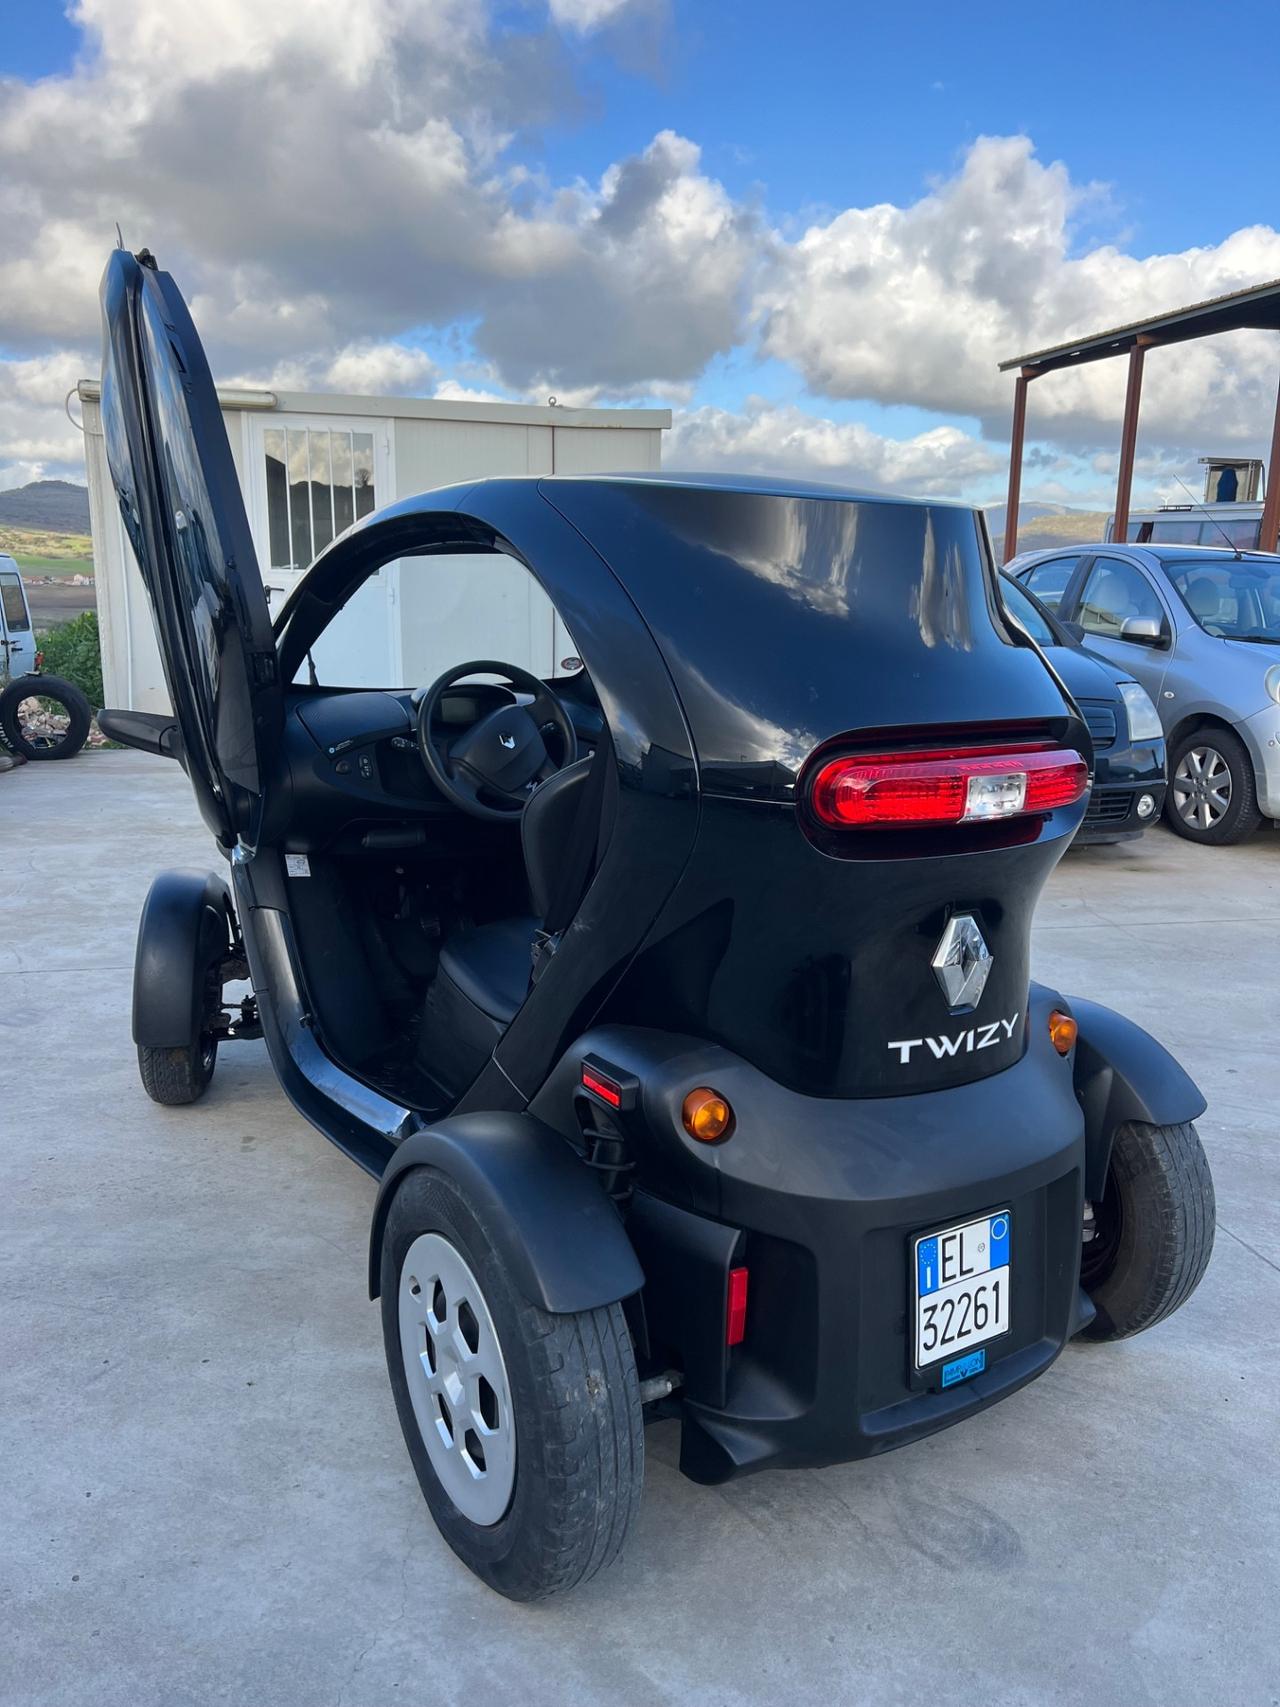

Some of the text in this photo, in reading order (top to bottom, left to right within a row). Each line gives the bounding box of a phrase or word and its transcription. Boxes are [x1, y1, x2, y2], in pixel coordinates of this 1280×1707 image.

[887, 1012, 1019, 1064] TWIZY
[941, 1231, 975, 1284] EL
[922, 1280, 1000, 1352] 32261
